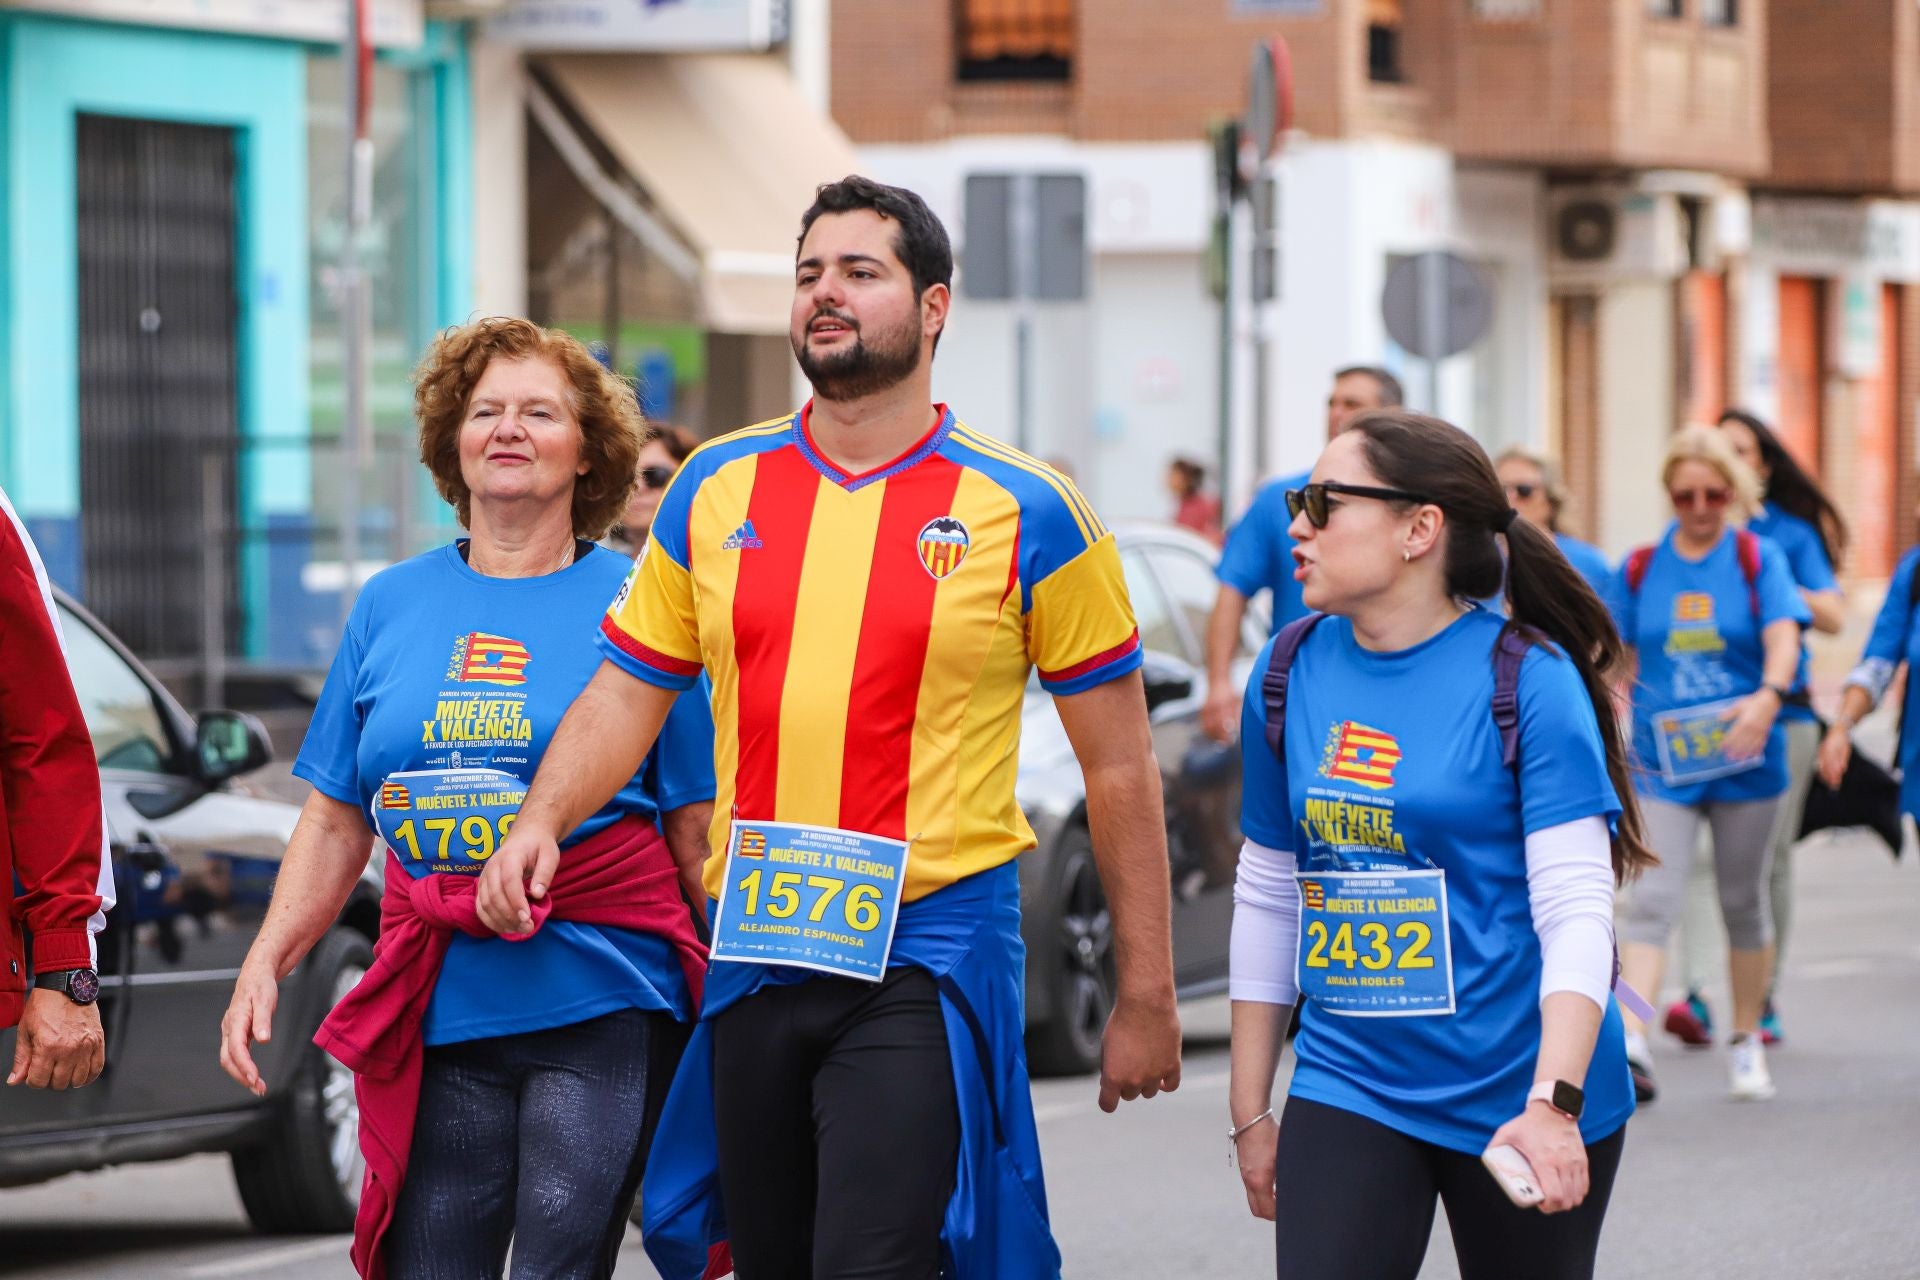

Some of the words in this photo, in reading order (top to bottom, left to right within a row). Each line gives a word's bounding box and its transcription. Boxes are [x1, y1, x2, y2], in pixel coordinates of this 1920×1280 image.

[723, 539, 763, 550] adidas
[435, 697, 525, 720] MUÉVETE
[422, 720, 436, 742] X
[441, 717, 532, 741] VALENCIA
[424, 742, 428, 750] A
[466, 740, 494, 748] AFECTADOS
[514, 740, 528, 748] DANA
[442, 776, 450, 784] 24
[416, 793, 467, 810] MUÉVETE
[469, 795, 478, 807] X
[480, 792, 528, 807] VALENC
[1306, 797, 1394, 832] MUÉVETE
[801, 831, 808, 839] 24
[810, 832, 843, 843] NOVIEMBRE
[845, 838, 860, 847] 2024
[432, 864, 452, 872] ANA
[454, 864, 485, 872] GONZ
[768, 846, 821, 867] MUÉVETE
[824, 855, 833, 868] X
[836, 856, 895, 880] VALENCIA
[739, 868, 884, 932] 1576
[1326, 896, 1365, 913] MUÉVETE
[1368, 899, 1376, 914] X
[1378, 896, 1437, 913] VALENCIA
[739, 922, 800, 936] ALEJANDRO
[803, 928, 865, 948] ESPINOSA
[1306, 920, 1434, 970] 2432
[1326, 976, 1358, 986] AMALIA
[1361, 976, 1405, 986] ROBLES
